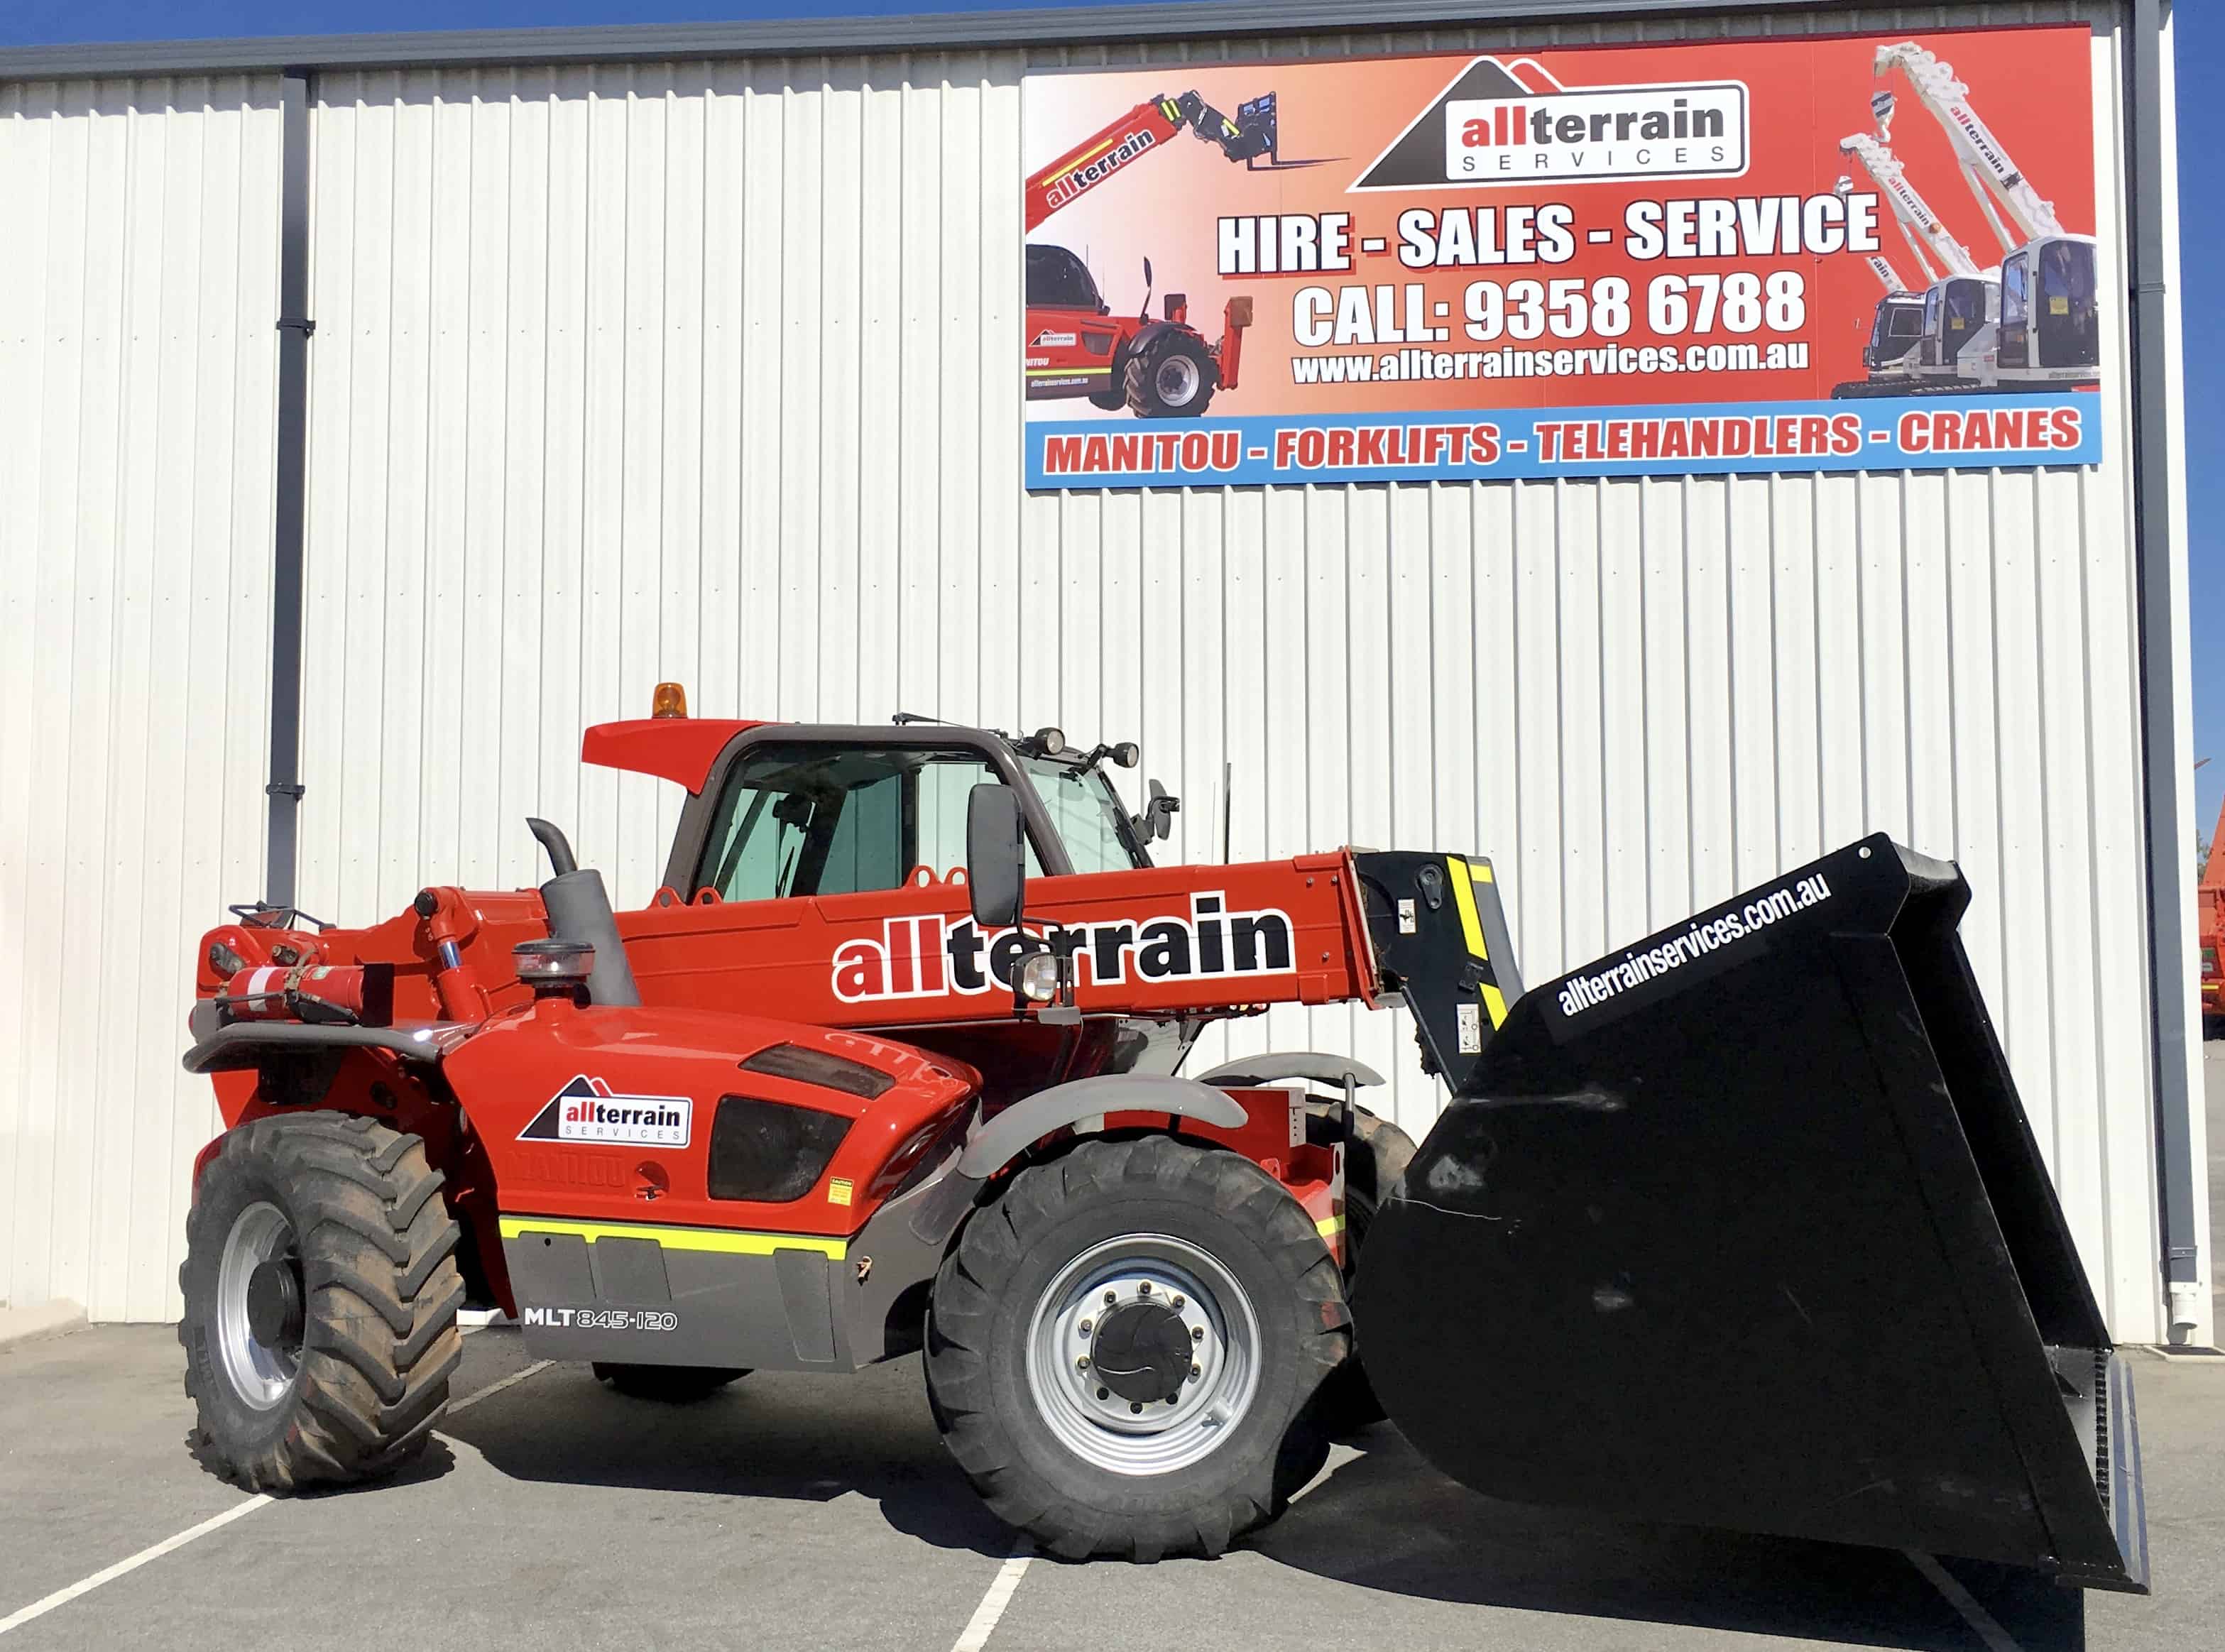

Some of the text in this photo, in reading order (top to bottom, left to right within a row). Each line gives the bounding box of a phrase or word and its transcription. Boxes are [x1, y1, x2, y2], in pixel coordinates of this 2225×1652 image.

[1461, 99, 1724, 148] allterrain
[1950, 106, 2004, 174] allterrain
[1046, 129, 1155, 208] allterrain
[1462, 146, 1724, 172] SERVICES
[1888, 177, 1930, 226] allterrain
[1217, 212, 1352, 275] HIRE
[1396, 203, 1576, 268] SALES
[1623, 192, 1881, 261] SERVICE
[1291, 269, 1806, 347] CALL: 9358 6788
[1291, 341, 1810, 385] www.allterrainservices.com.au
[1042, 430, 1242, 474] MANITOU
[1274, 422, 1500, 469] FORKLIFTS
[1532, 411, 1861, 463] TELEHANDLERS
[1898, 407, 2082, 455] CRANES
[1558, 873, 1832, 1017] allterrainservices.com.au
[565, 1125, 680, 1140] SERVICES
[566, 1101, 680, 1127] allterrain
[525, 1307, 679, 1331] MLT 845-120
